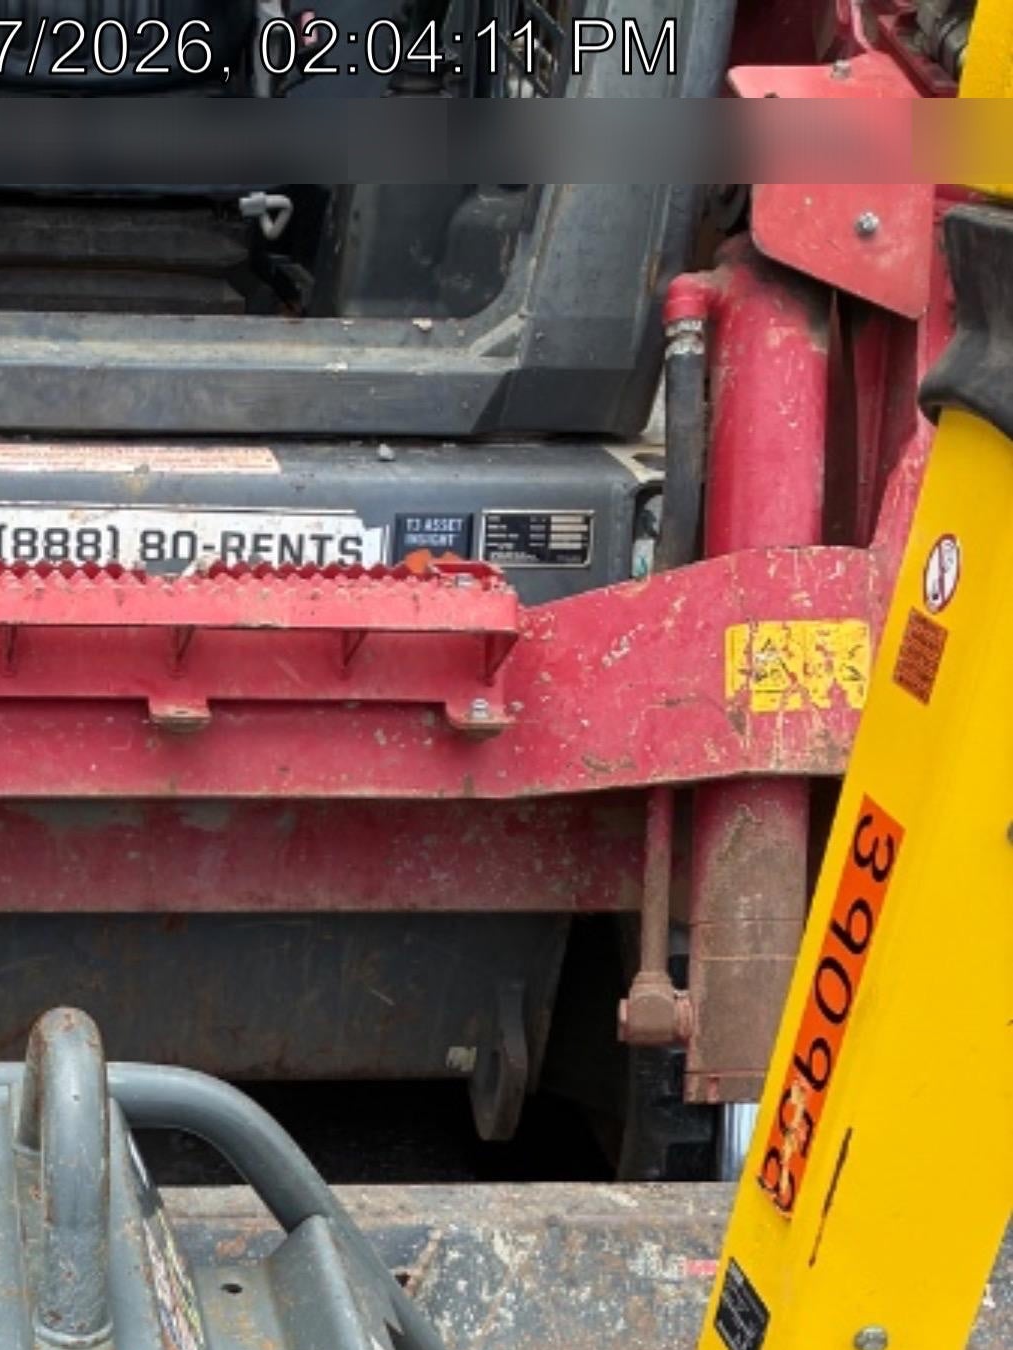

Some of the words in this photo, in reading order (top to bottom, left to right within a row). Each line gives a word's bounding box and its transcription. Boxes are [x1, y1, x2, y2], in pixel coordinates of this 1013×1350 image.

[423, 518, 463, 532] ASSET
[404, 533, 457, 547] INSIGHT
[140, 528, 363, 567] 80-RENTS
